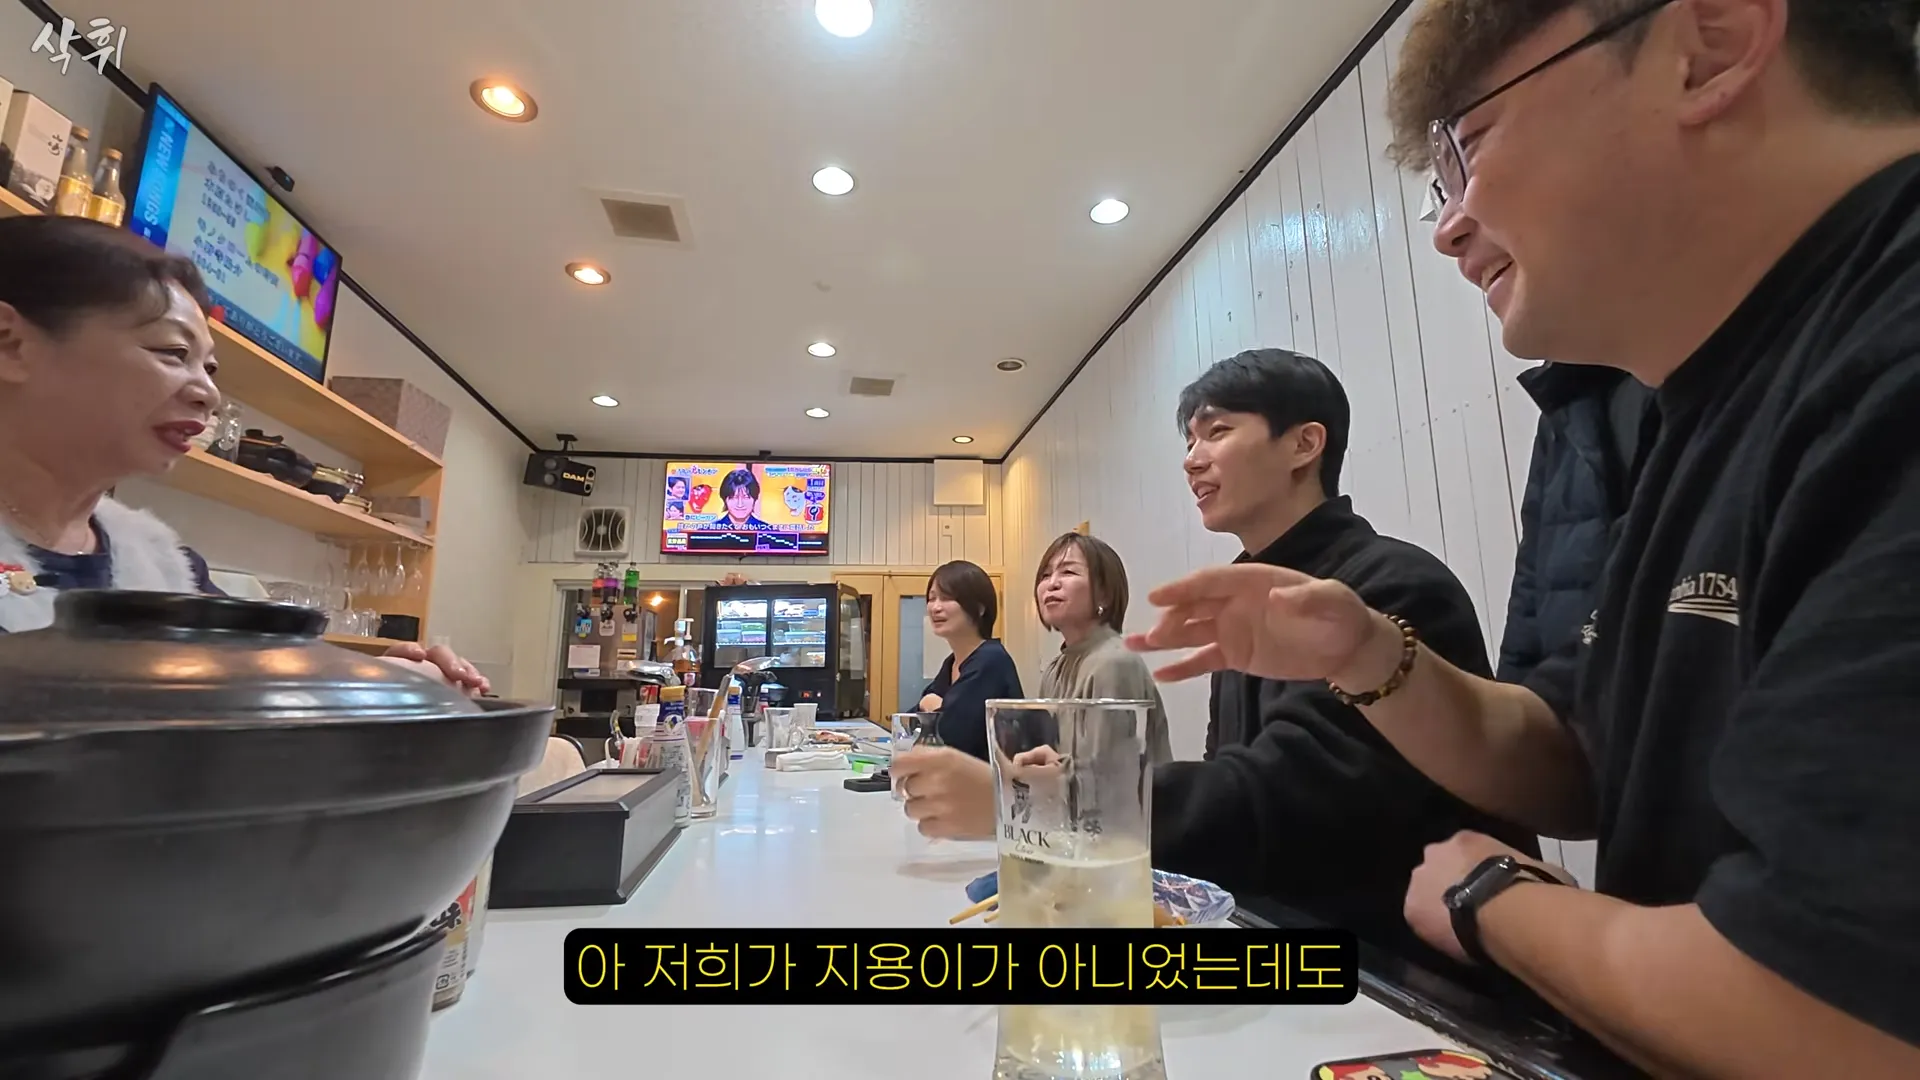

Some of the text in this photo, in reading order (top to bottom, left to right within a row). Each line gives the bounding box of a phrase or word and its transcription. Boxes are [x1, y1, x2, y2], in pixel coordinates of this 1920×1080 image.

[562, 472, 585, 483] DAM
[1698, 572, 1738, 600] 1754
[1003, 823, 1051, 849] BLACK
